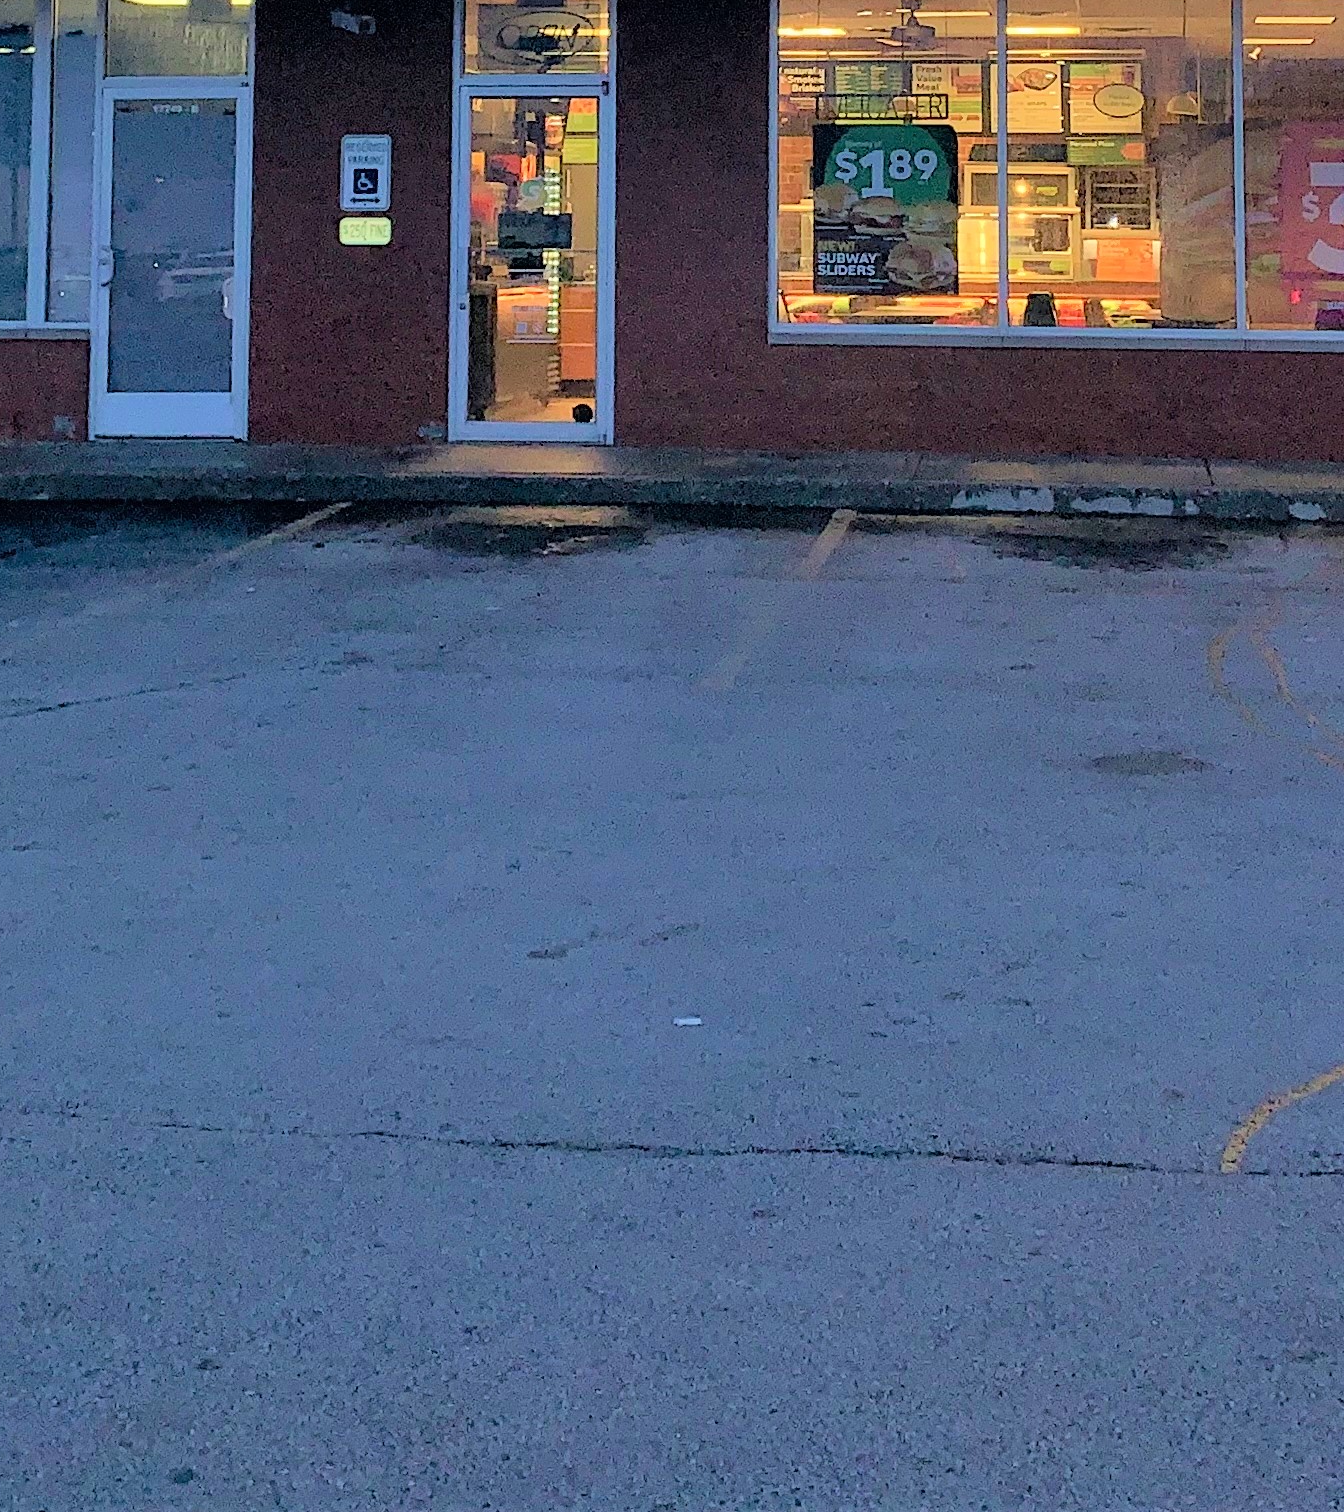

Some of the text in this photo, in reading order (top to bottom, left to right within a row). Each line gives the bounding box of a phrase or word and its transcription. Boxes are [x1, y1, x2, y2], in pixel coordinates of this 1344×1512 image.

[916, 75, 942, 83] Value
[817, 252, 878, 264] SUBWAY
[817, 264, 876, 276] SLIDERS
